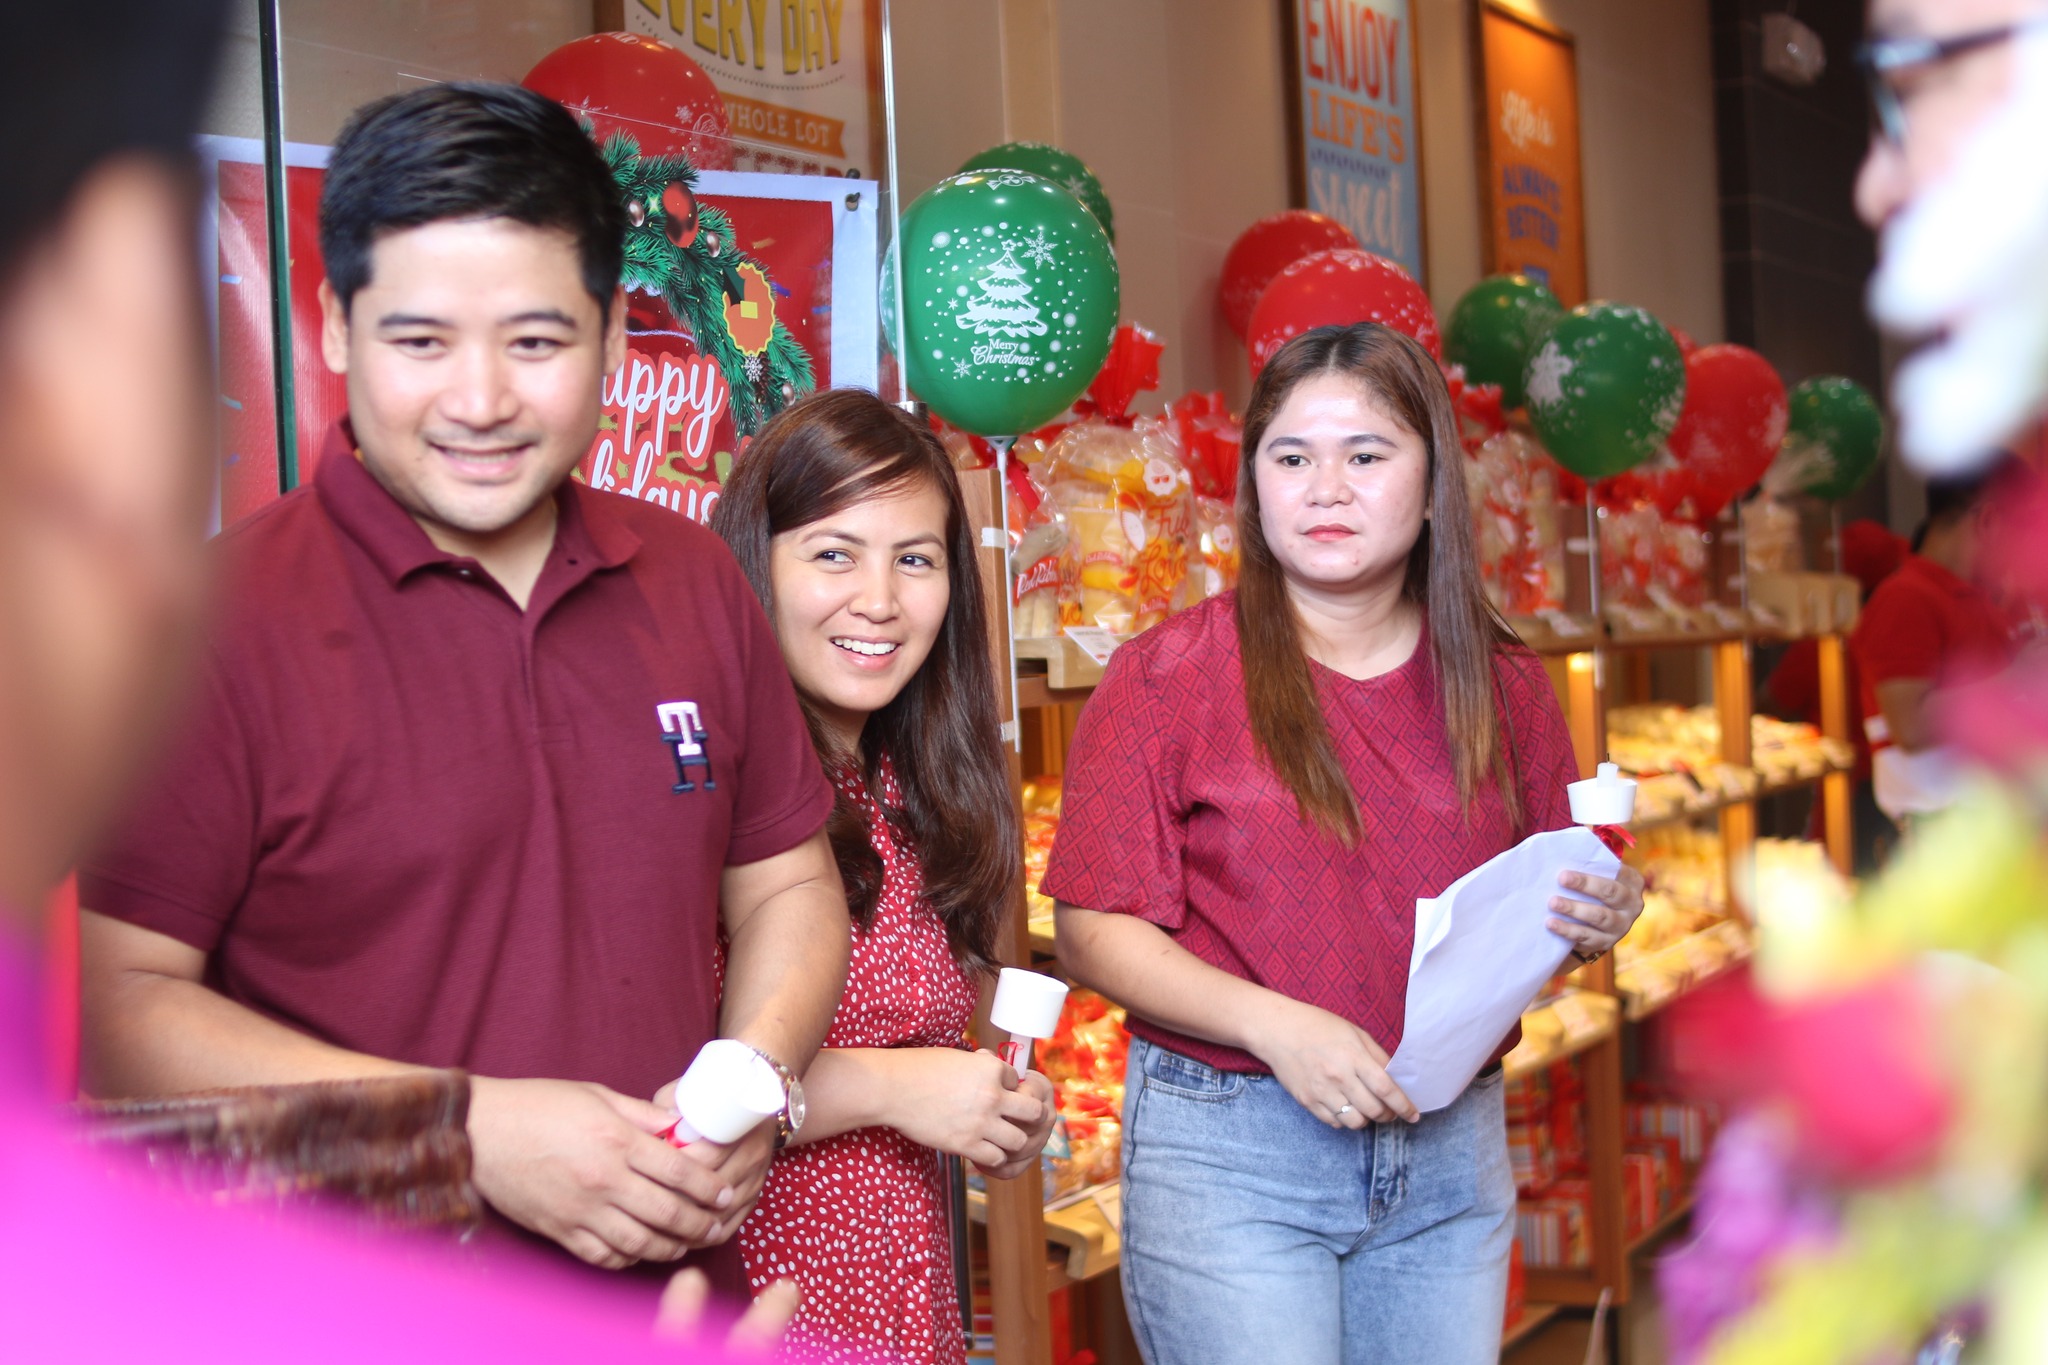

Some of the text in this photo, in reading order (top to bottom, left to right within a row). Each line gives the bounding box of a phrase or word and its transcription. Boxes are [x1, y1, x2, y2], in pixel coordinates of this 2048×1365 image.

[781, 0, 844, 75] DAY
[1305, 0, 1399, 106] ENJOY
[794, 118, 831, 147] LOT
[1308, 88, 1406, 164] LIFE'S
[970, 346, 1036, 366] Christmas
[988, 338, 1019, 353] Merry
[601, 358, 724, 459] appy
